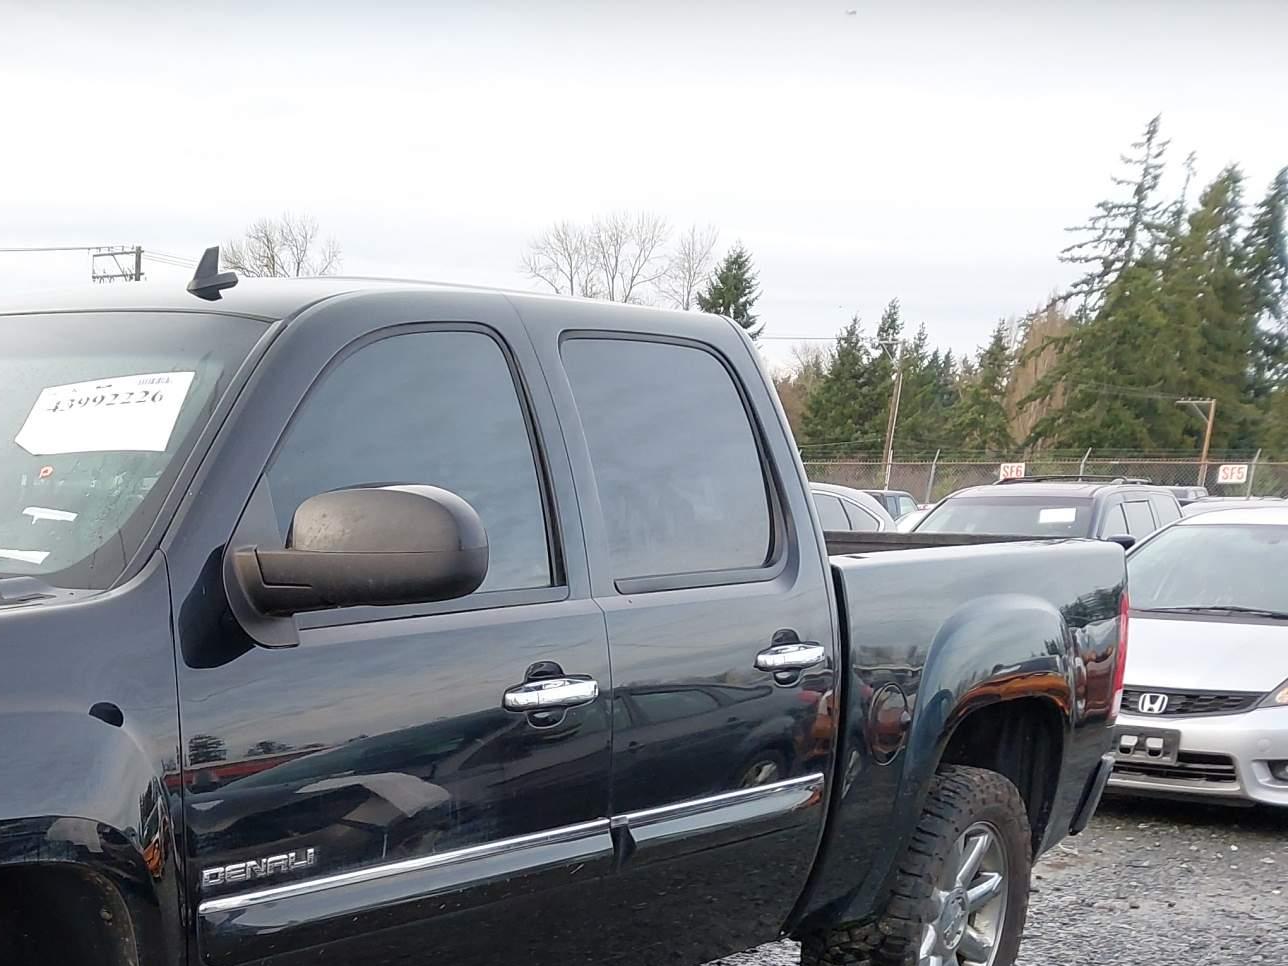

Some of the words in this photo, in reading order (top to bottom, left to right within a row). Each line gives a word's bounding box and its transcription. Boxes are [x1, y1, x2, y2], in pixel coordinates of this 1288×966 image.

[47, 389, 164, 413] 43992226
[1002, 464, 1023, 478] SF6
[1221, 466, 1246, 480] SF5
[202, 847, 316, 887] DENALI
